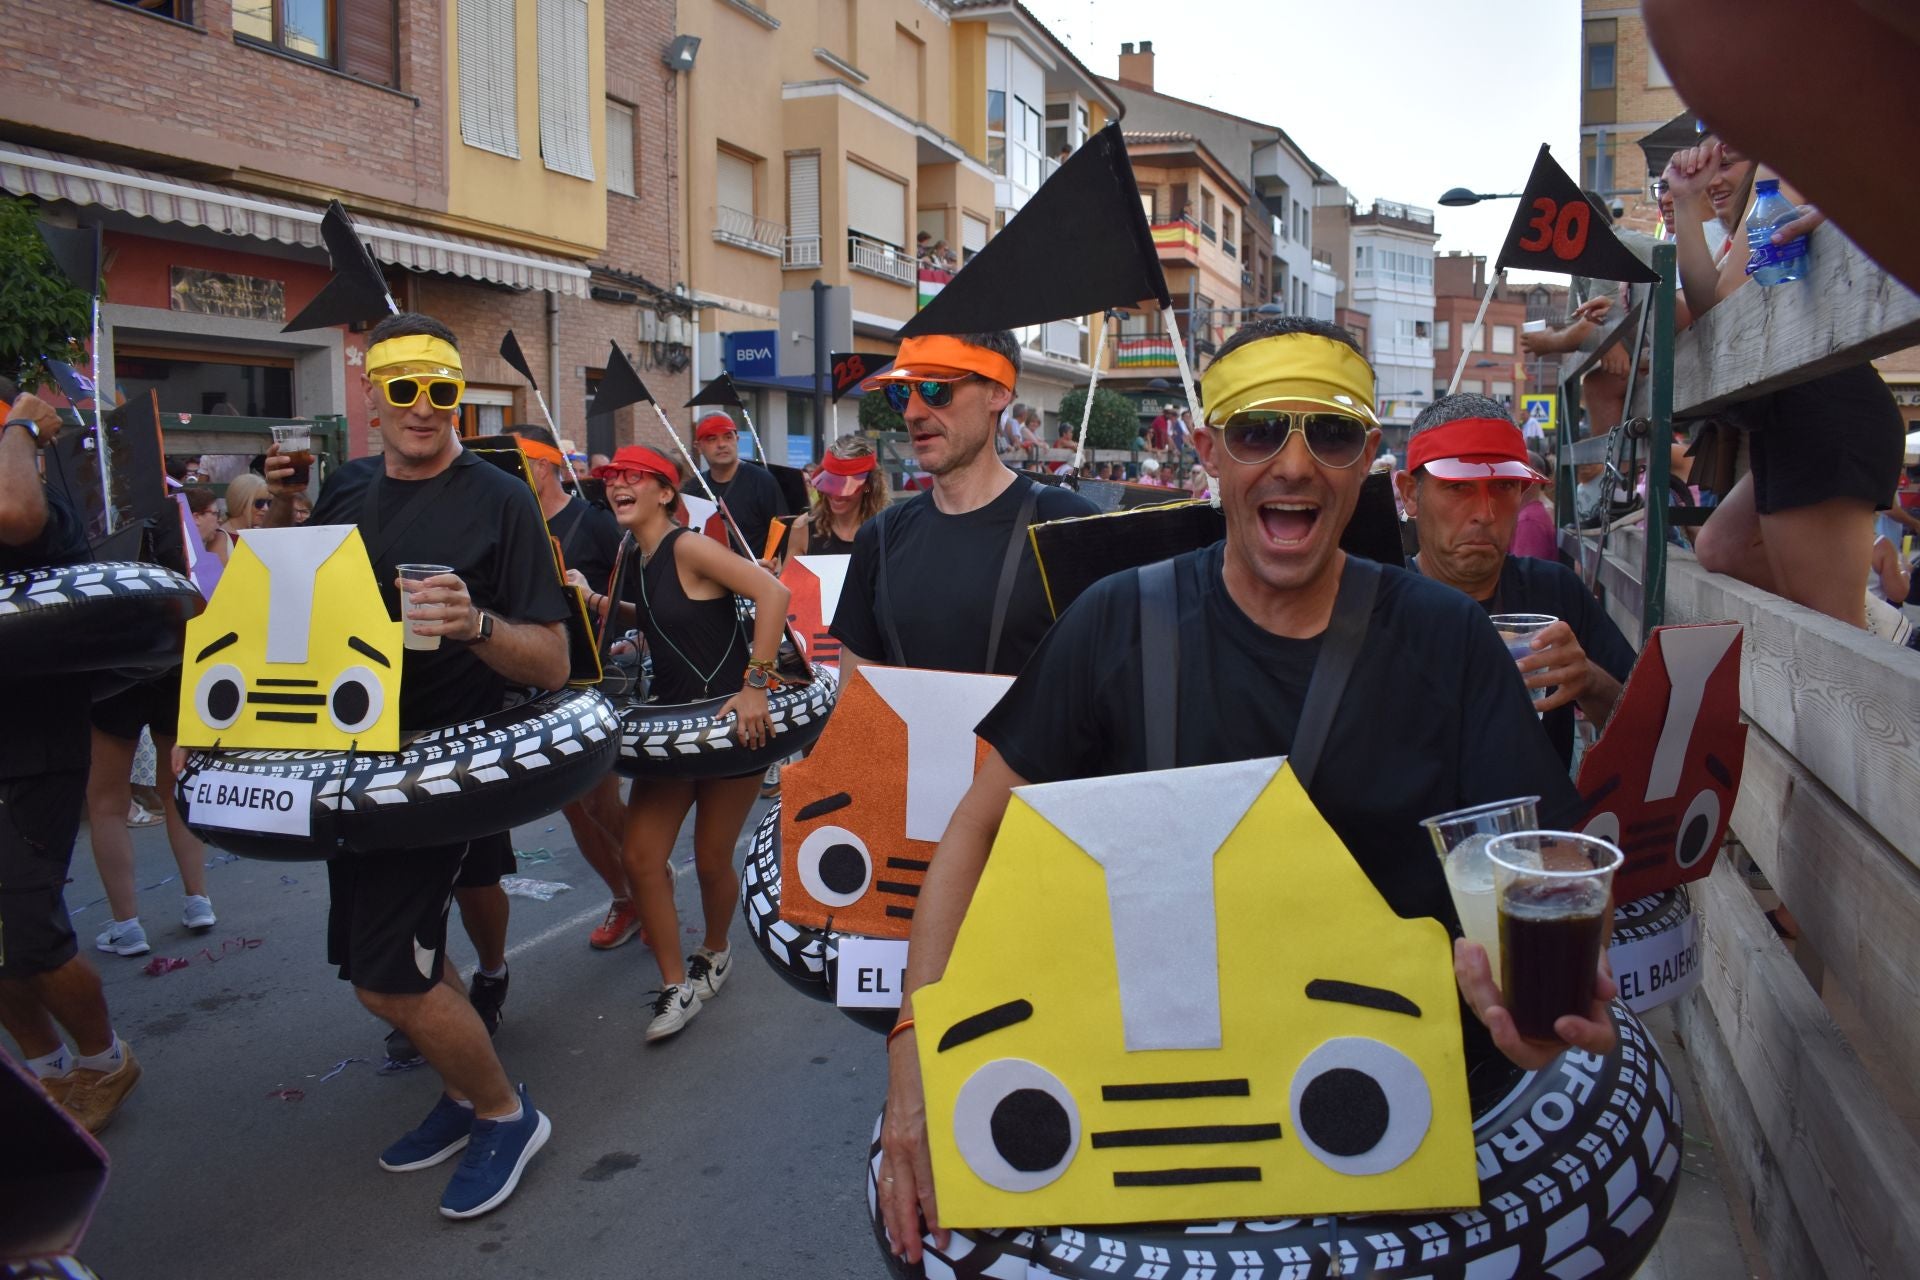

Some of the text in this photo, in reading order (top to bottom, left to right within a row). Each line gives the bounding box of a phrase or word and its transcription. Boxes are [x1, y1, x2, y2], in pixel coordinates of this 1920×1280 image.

[1519, 197, 1590, 260] 30
[736, 347, 772, 361] BBVA
[833, 354, 865, 389] 28
[196, 783, 294, 812] EL BAJERO
[858, 968, 890, 993] EL
[1620, 942, 1699, 1001] EL BAJERO
